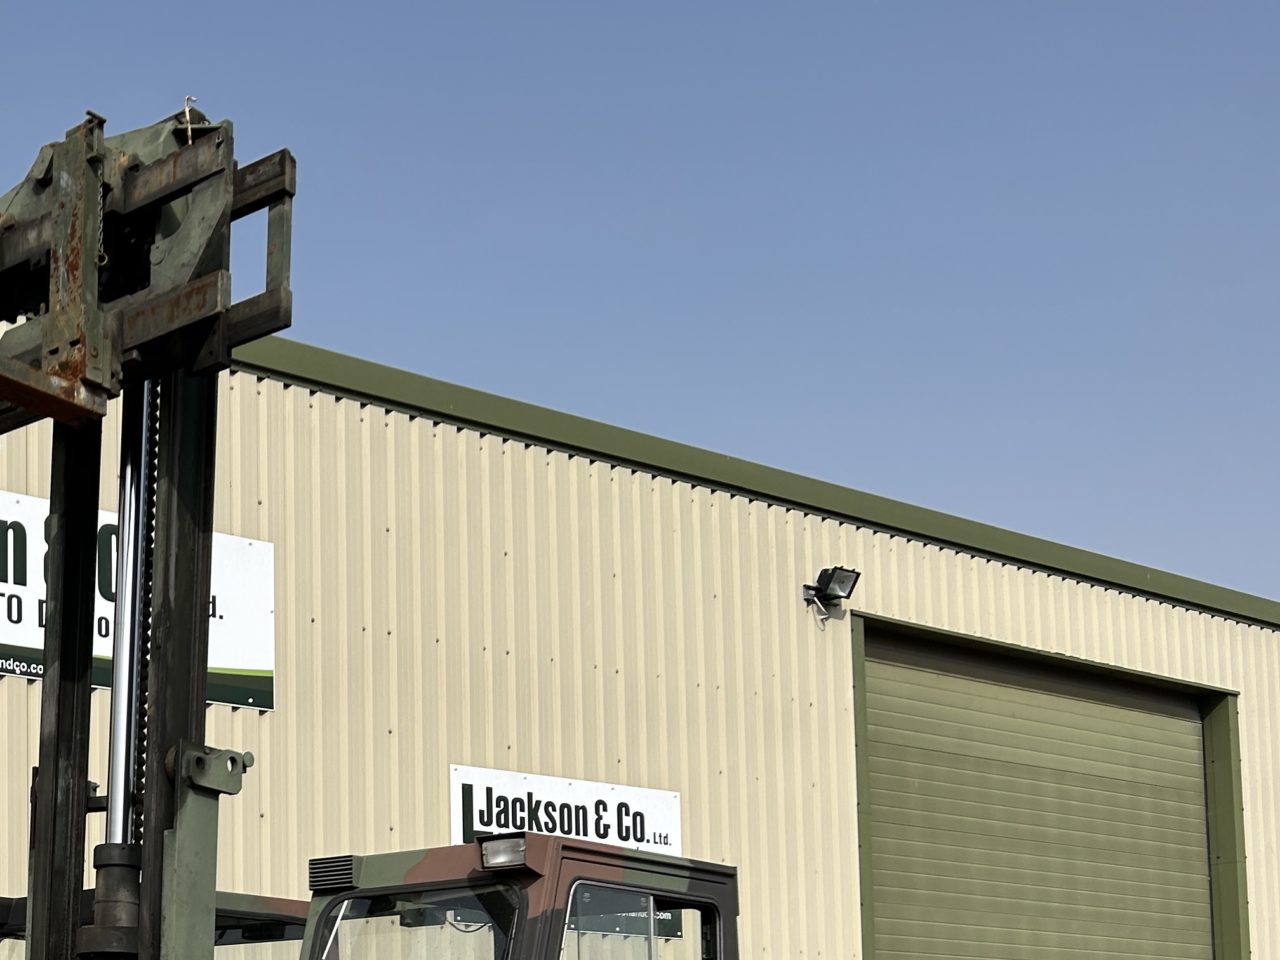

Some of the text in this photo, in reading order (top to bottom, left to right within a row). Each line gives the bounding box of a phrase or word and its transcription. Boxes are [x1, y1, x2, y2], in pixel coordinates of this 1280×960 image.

[594, 799, 611, 840] &
[616, 801, 651, 844] Co.
[653, 832, 672, 846] Ltd.
